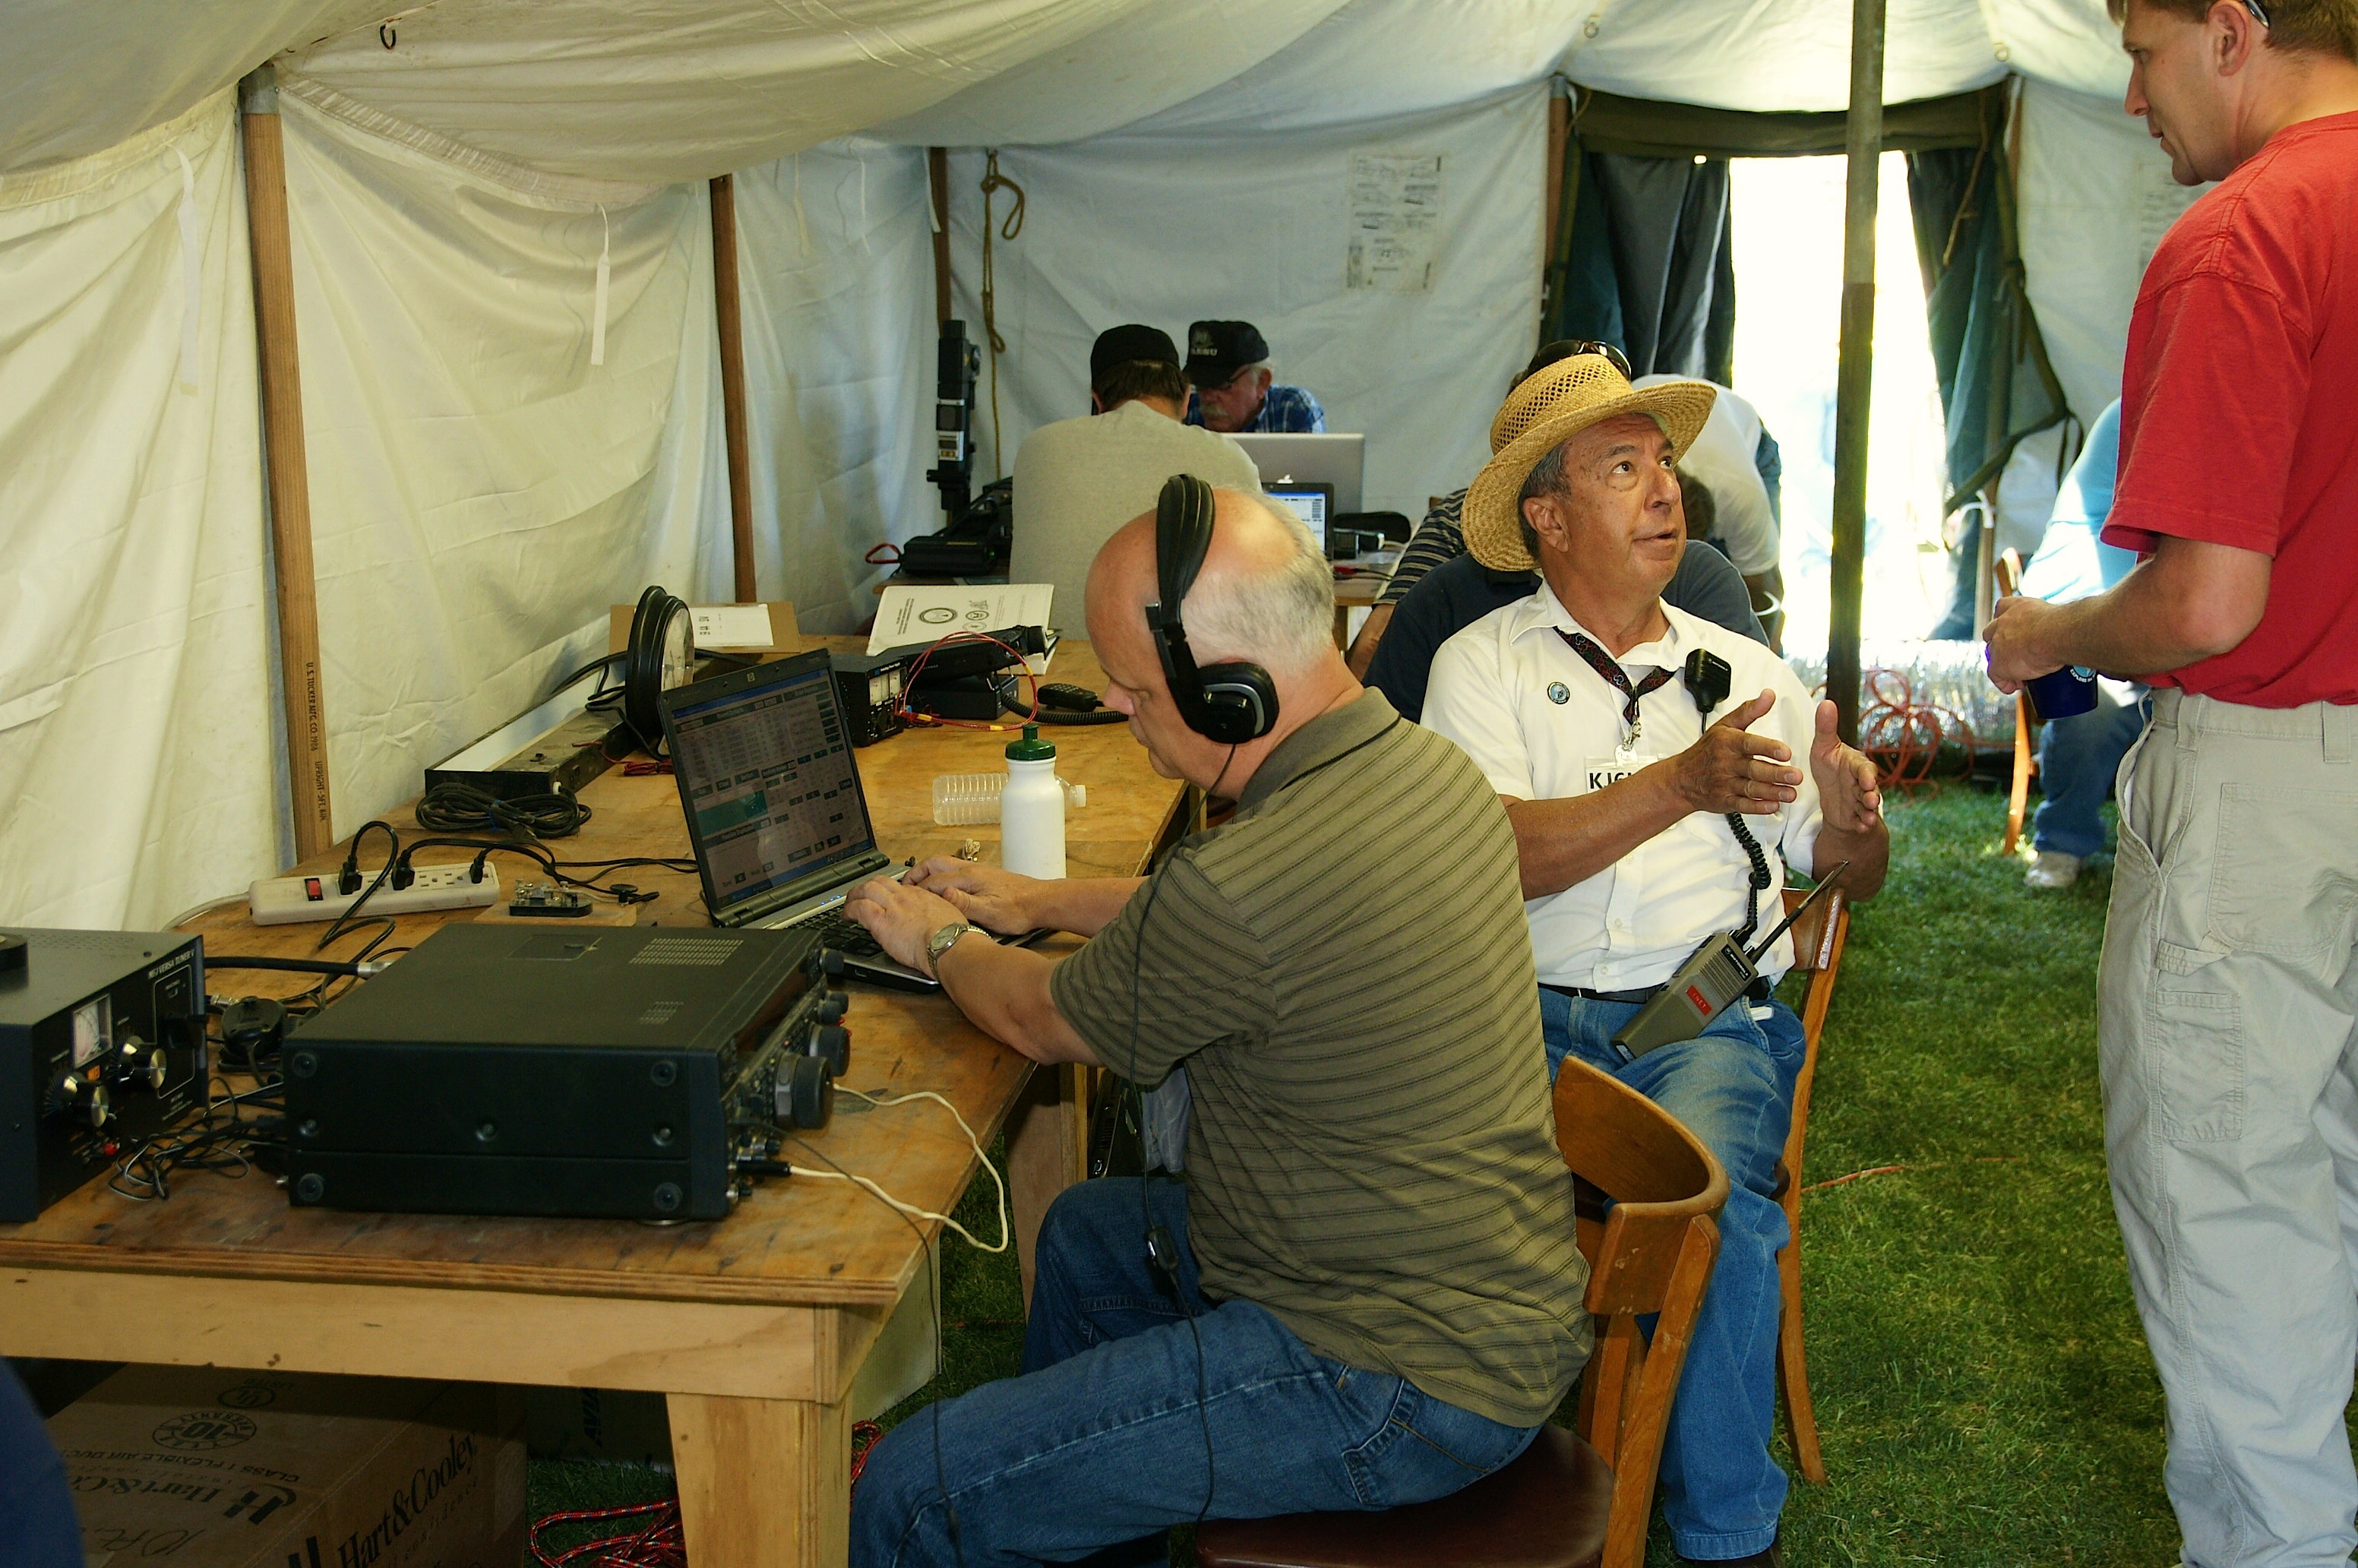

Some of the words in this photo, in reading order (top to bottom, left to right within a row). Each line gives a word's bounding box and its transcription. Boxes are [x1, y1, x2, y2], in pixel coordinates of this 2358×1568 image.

[307, 676, 315, 705] TUCKER
[1729, 953, 1749, 976] MOTOROLA
[142, 1452, 226, 1468] FLEXIBLE
[242, 1462, 300, 1483] CLASS
